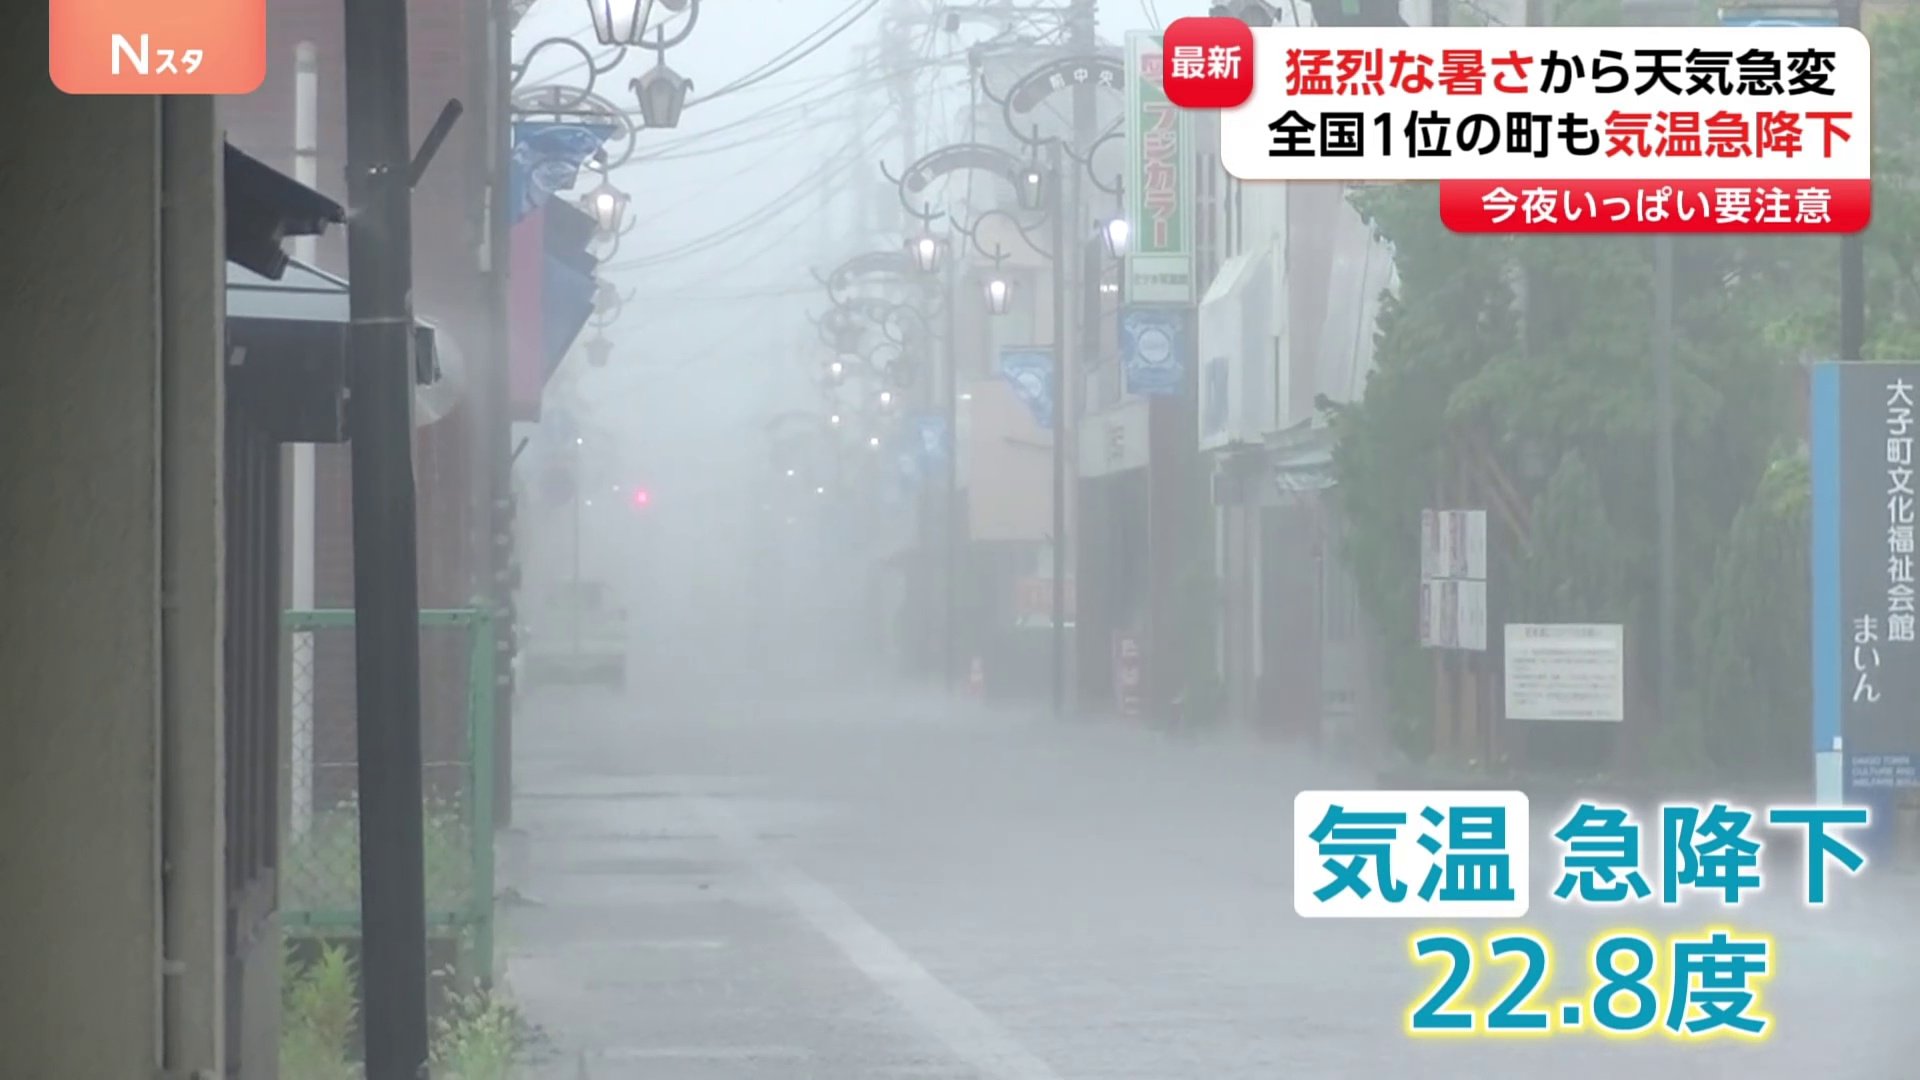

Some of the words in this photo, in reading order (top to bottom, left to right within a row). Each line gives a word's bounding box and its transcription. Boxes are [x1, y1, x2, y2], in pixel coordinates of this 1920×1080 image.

[1886, 378, 1915, 641] 大子町文化福祉会館
[1852, 613, 1881, 703] まいん
